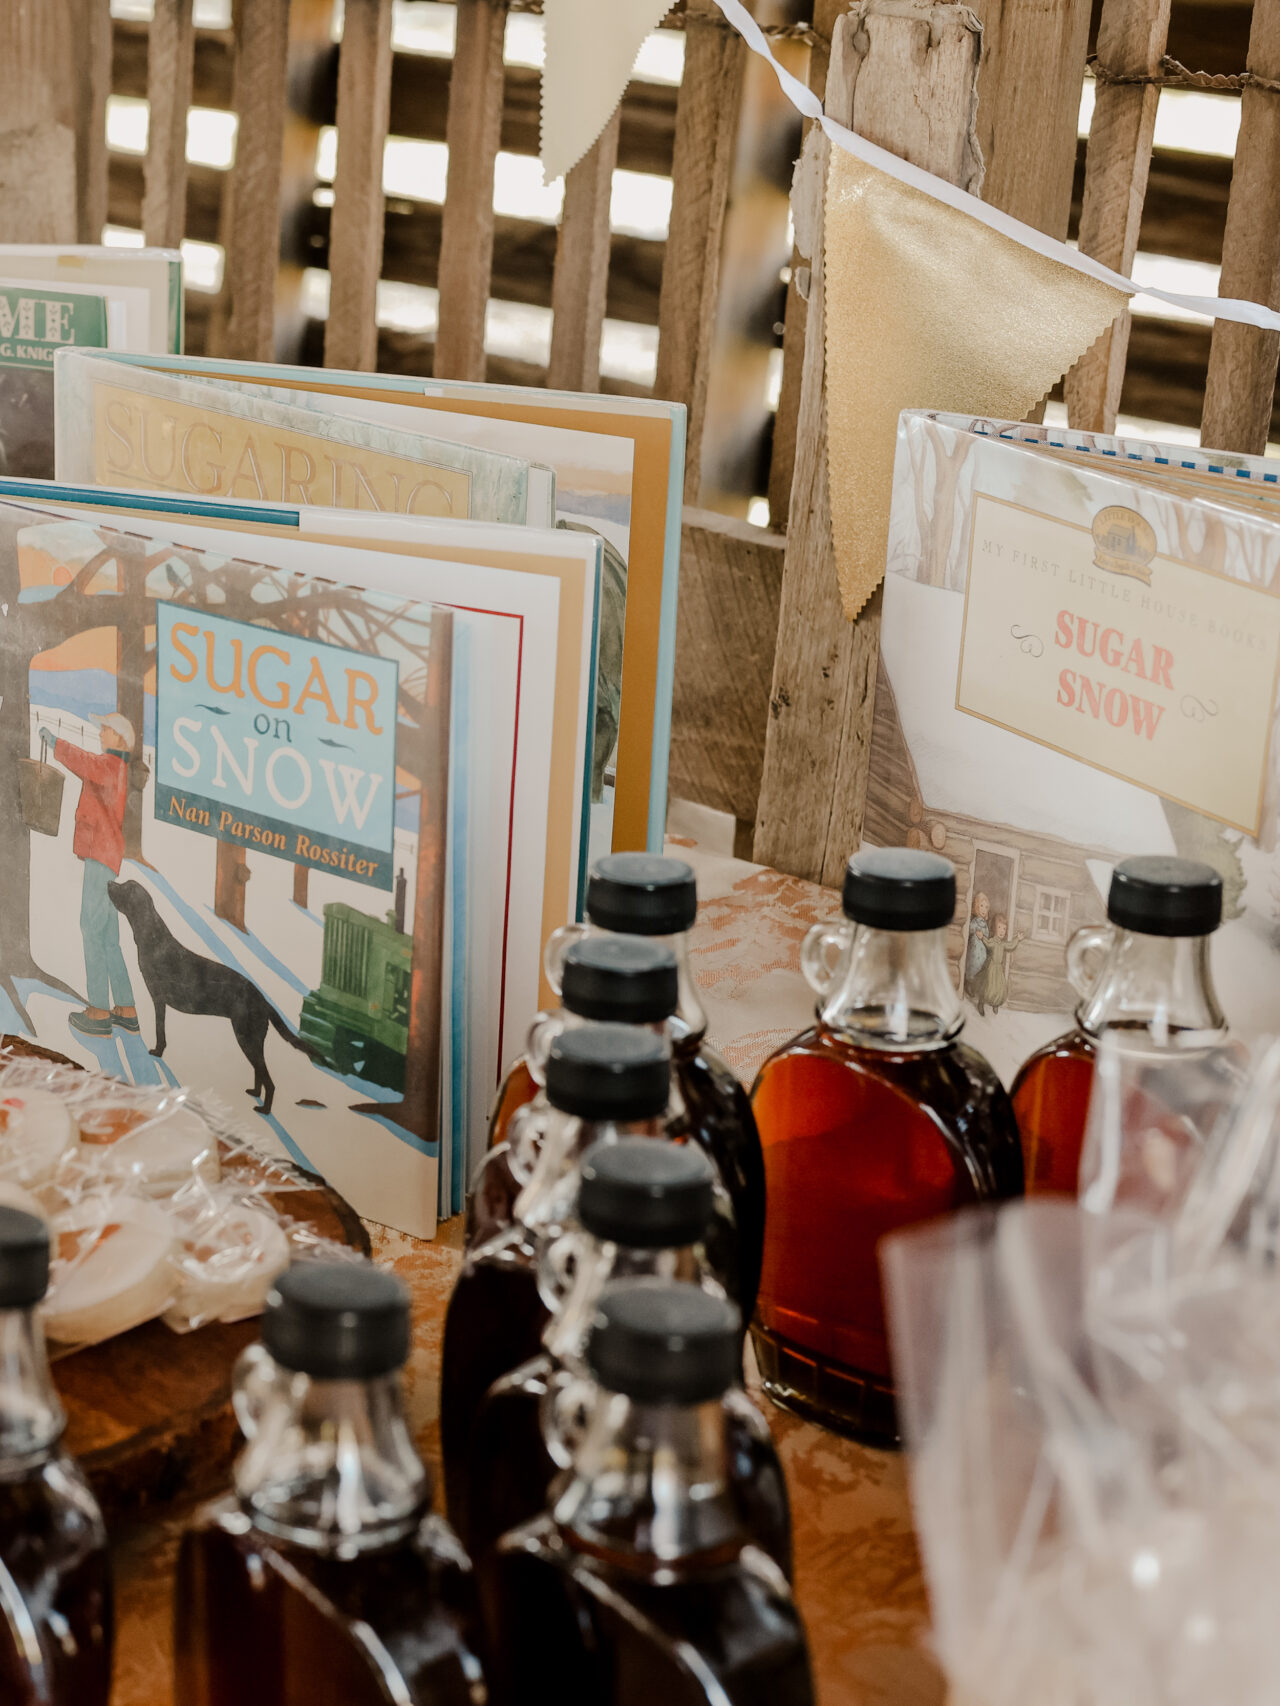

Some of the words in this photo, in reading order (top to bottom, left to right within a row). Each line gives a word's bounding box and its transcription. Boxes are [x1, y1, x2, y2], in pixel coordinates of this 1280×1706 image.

[16, 344, 54, 362] KNIG
[981, 538, 1006, 557] MY
[1012, 549, 1061, 577] FIRST
[1068, 569, 1132, 603] LITTLE
[1141, 594, 1200, 628] HOUSE
[1208, 618, 1268, 652] BOOKS
[169, 621, 384, 736] SUGAR
[1054, 609, 1176, 691] SUGAR
[253, 712, 293, 743] on
[1056, 668, 1166, 742] SNOW
[171, 716, 384, 831] SNOW
[168, 795, 211, 827] Nan
[218, 809, 287, 850] Parson
[294, 833, 379, 878] Rossiter
